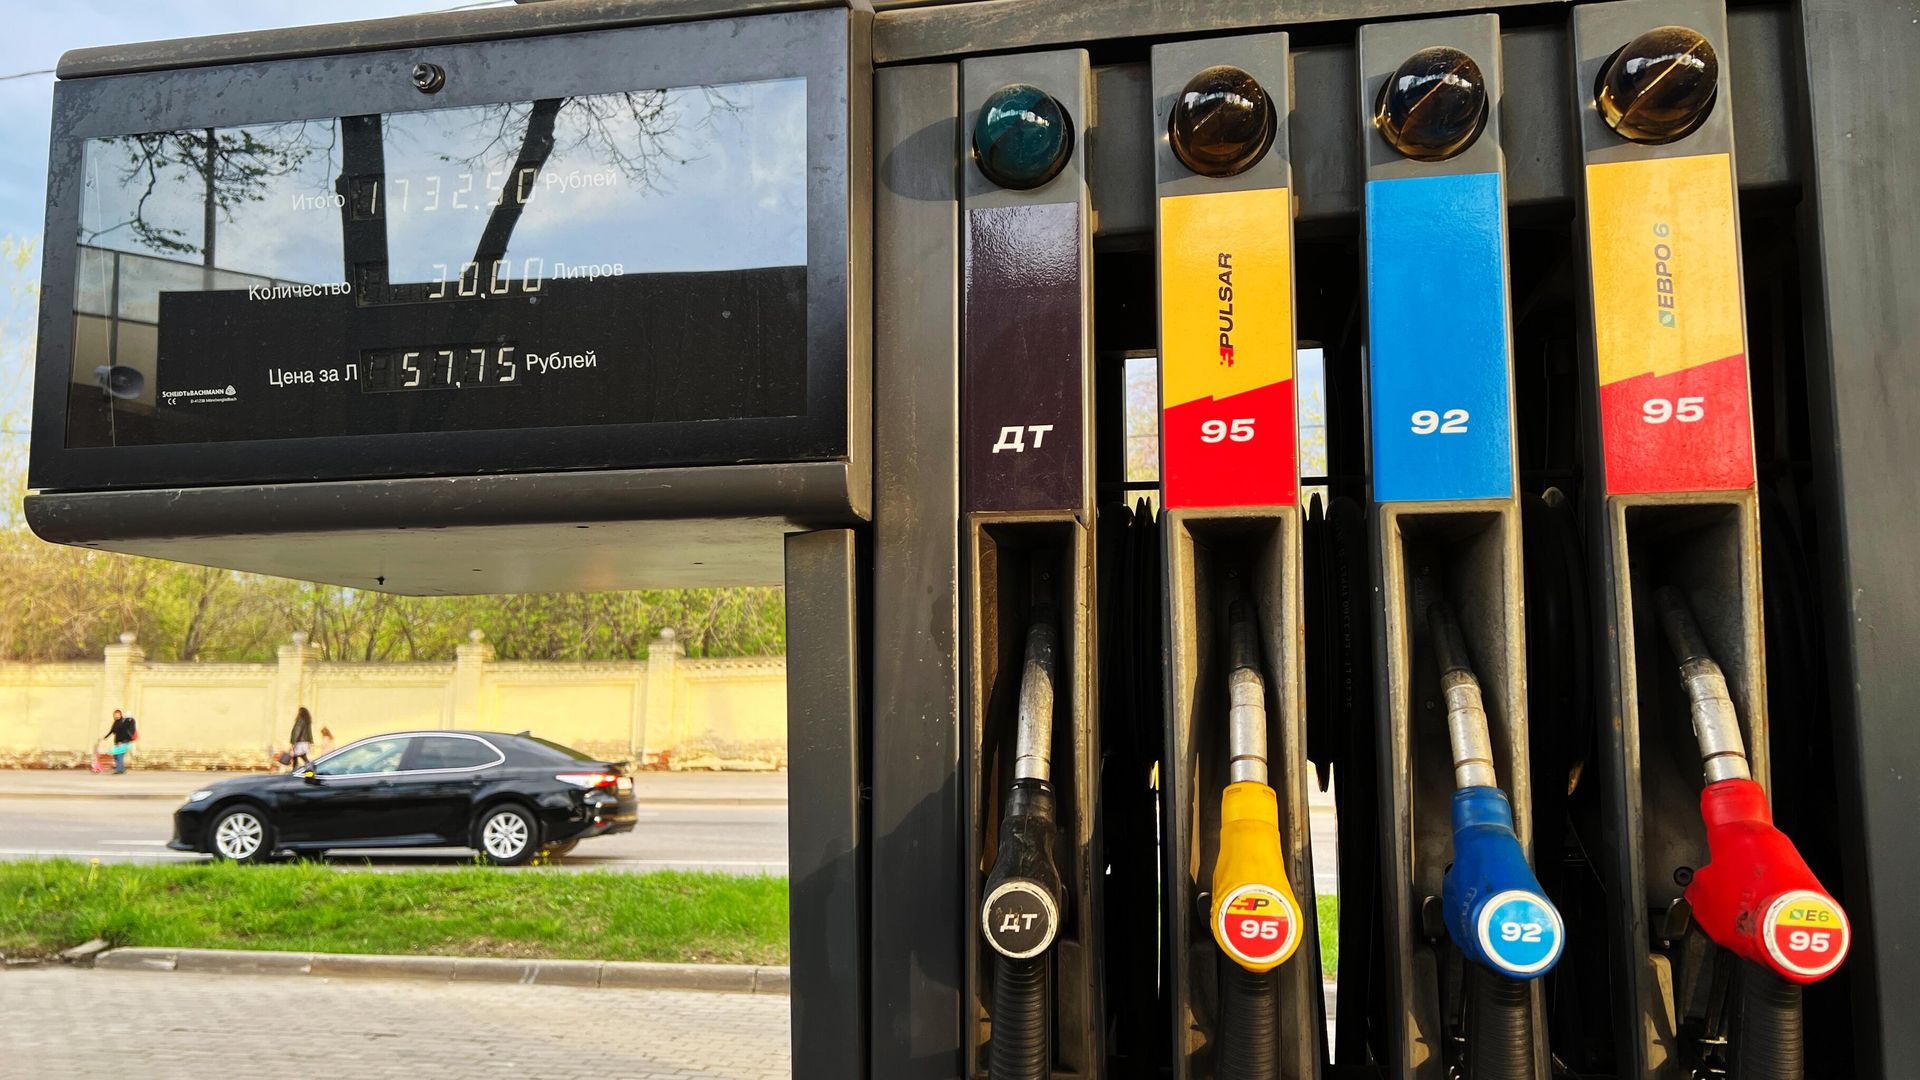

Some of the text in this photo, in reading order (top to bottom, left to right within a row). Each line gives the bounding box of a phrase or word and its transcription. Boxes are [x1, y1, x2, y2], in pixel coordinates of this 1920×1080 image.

[291, 193, 346, 211] Итого
[546, 169, 617, 193] Рублей
[1652, 223, 1675, 309] ЕВРО 6
[248, 281, 352, 301] Количество
[552, 262, 624, 282] Литров
[1218, 252, 1234, 349] PULSAR
[269, 368, 315, 388] Цена
[319, 368, 339, 383] за
[344, 363, 358, 381] Л
[526, 350, 597, 374] Рублей
[1411, 409, 1470, 435] 92
[1642, 396, 1705, 424] 95
[992, 424, 1054, 454] ДТ
[1200, 418, 1256, 444] 95
[999, 913, 1038, 933] ДТ
[1240, 919, 1280, 940] 95
[1501, 922, 1543, 943] 92
[1789, 930, 1831, 953] 95
